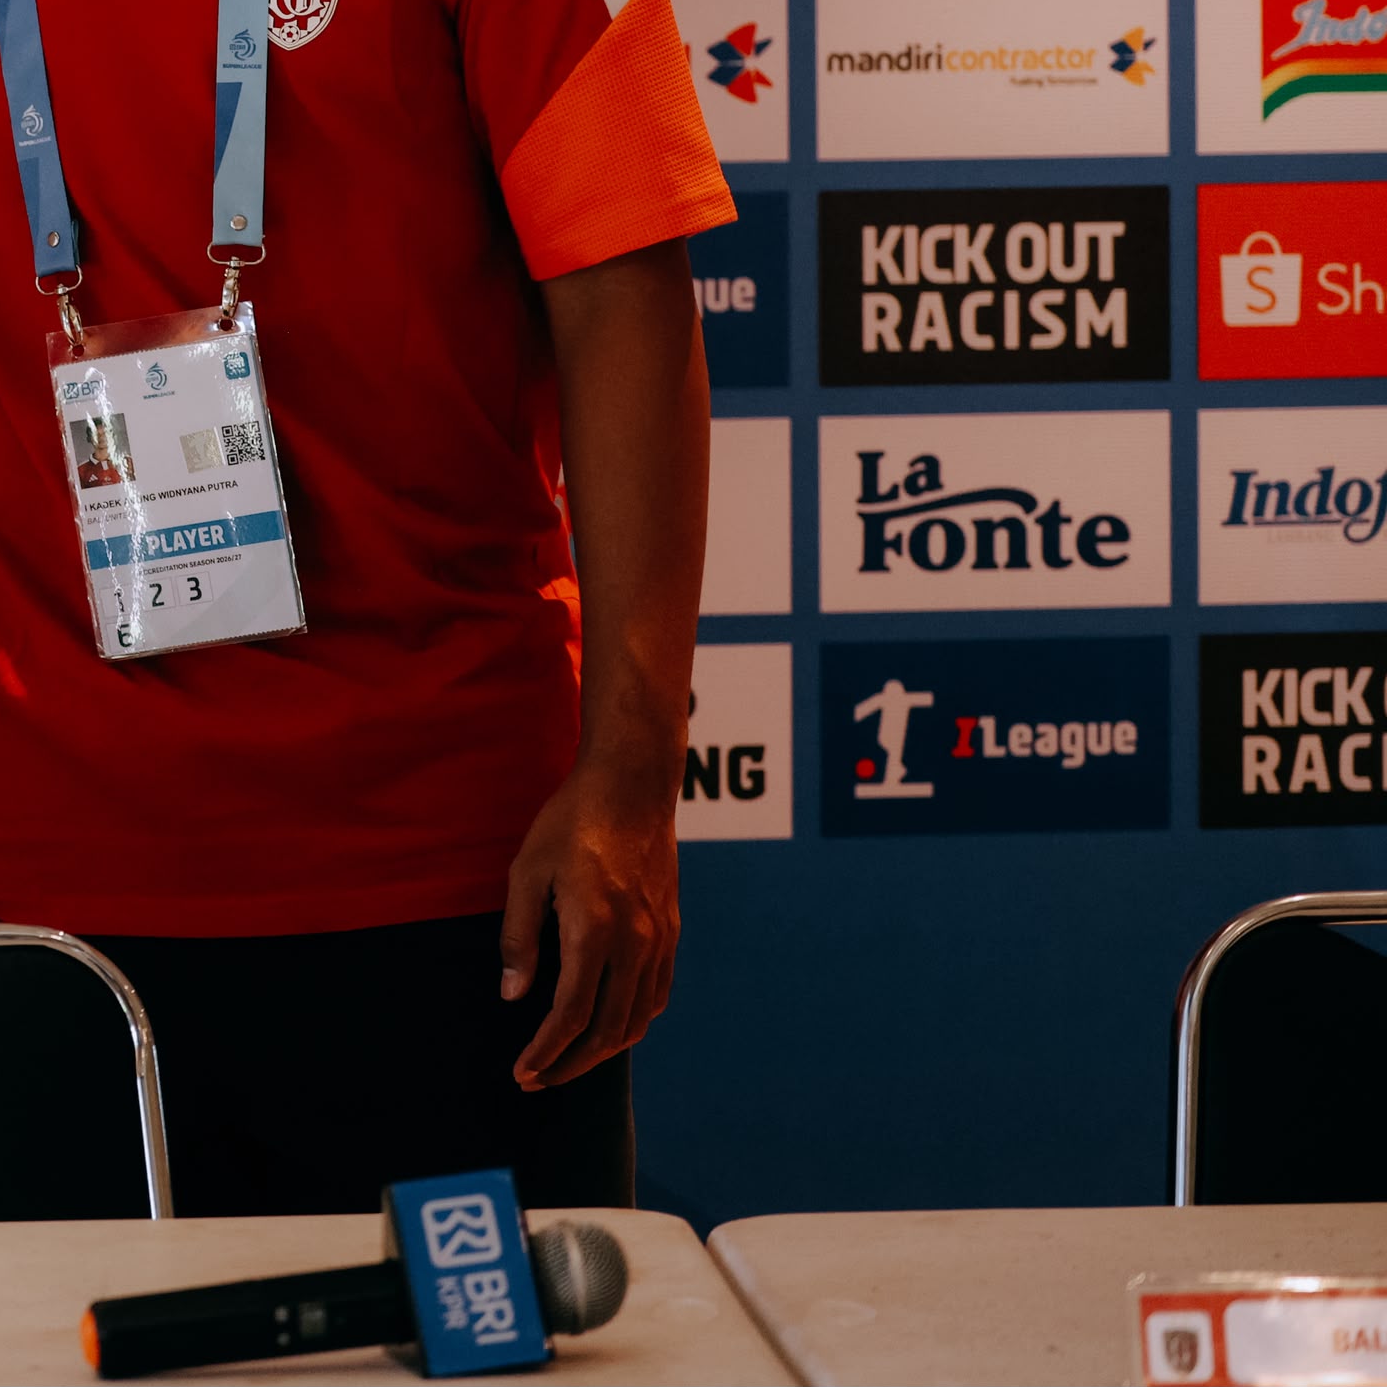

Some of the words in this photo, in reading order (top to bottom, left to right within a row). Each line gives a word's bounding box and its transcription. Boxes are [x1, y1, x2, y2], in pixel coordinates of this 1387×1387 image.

[827, 41, 1098, 75] mandiricontractor
[861, 223, 995, 286] KICK
[1005, 221, 1126, 285] OUT
[862, 288, 1129, 353] RACISM
[157, 485, 207, 500] WIDNYANA
[207, 479, 239, 492] PUTRA
[855, 450, 944, 505] La
[1222, 465, 1387, 545] Indof
[145, 524, 226, 557] PLAYER
[189, 557, 216, 570] SEASON
[856, 500, 1132, 573] Fonte
[149, 582, 165, 608] 2
[186, 576, 202, 602] 3
[1242, 667, 1374, 728] KICK
[1242, 733, 1387, 794] RAC
[462, 1267, 519, 1346] BRI
